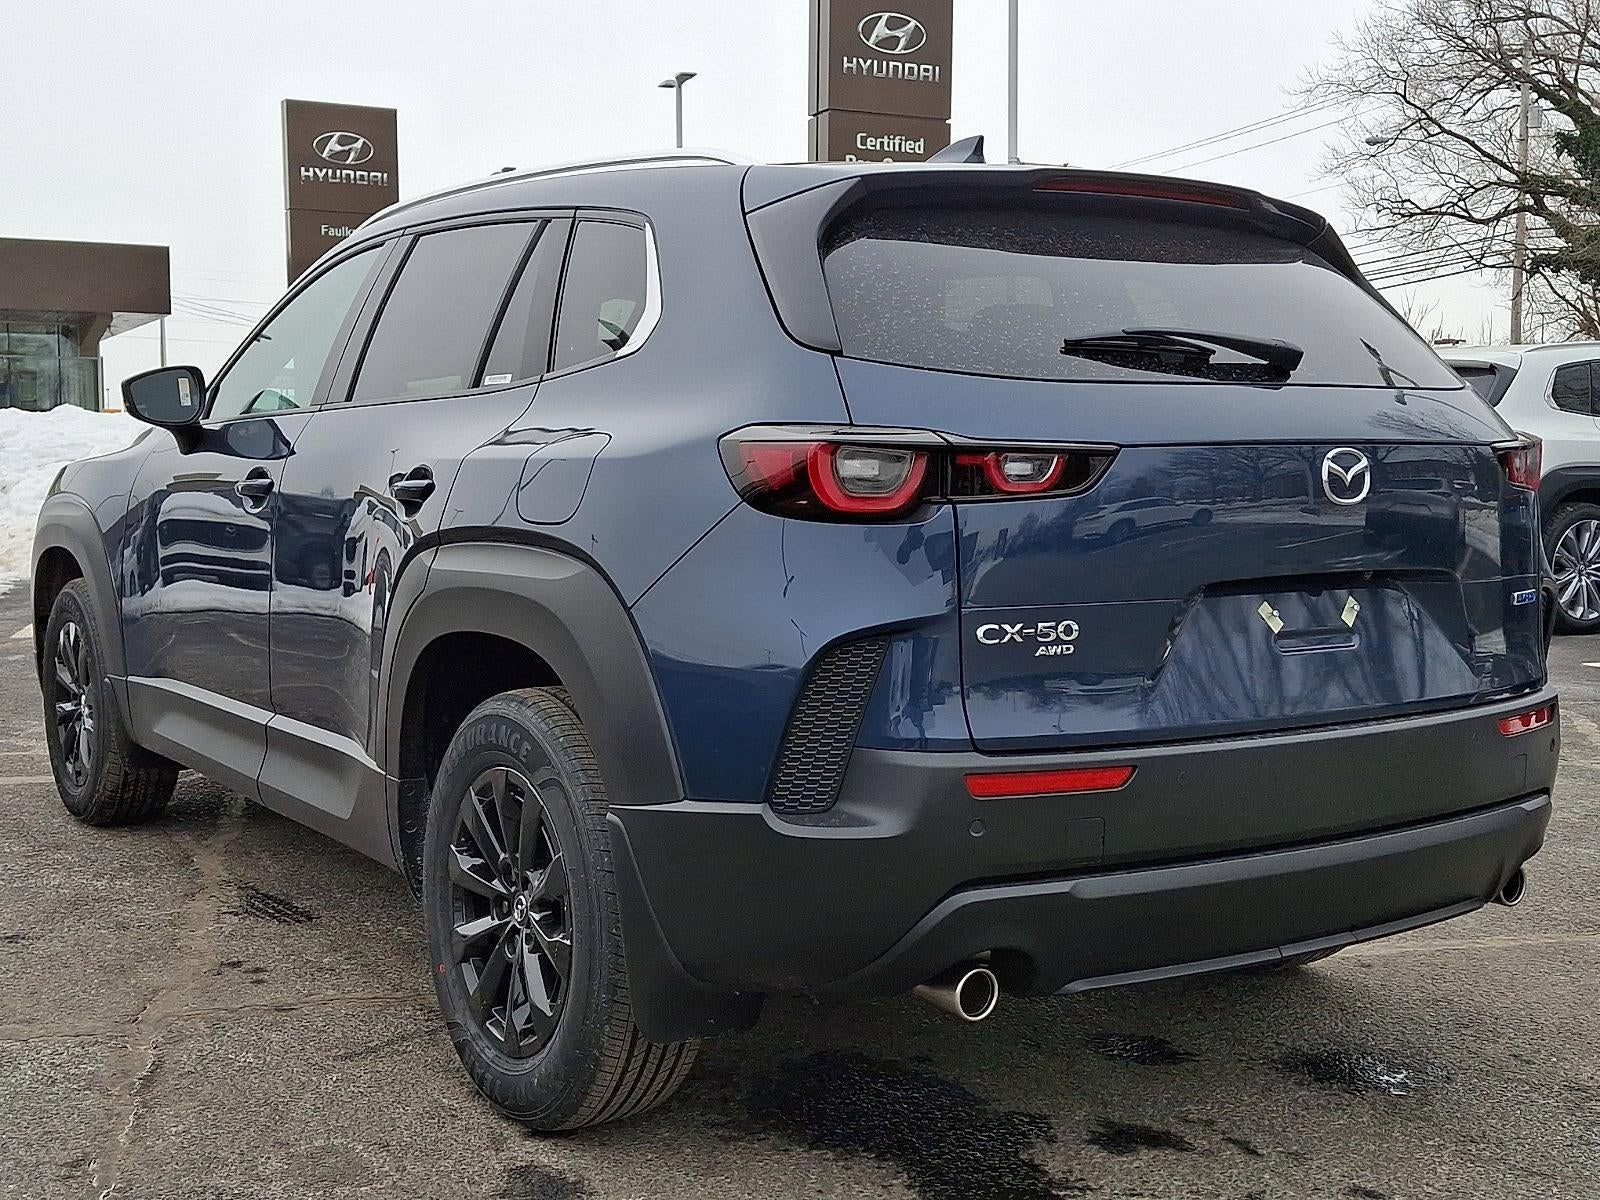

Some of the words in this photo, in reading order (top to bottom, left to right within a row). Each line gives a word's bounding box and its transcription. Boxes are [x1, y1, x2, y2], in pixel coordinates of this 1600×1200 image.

[842, 56, 940, 82] HYUNDAI
[856, 132, 925, 154] Certified
[300, 166, 388, 187] HYUNDAI
[321, 224, 355, 237] Faulk
[976, 620, 1080, 645] CX-50
[1034, 644, 1075, 657] AWD
